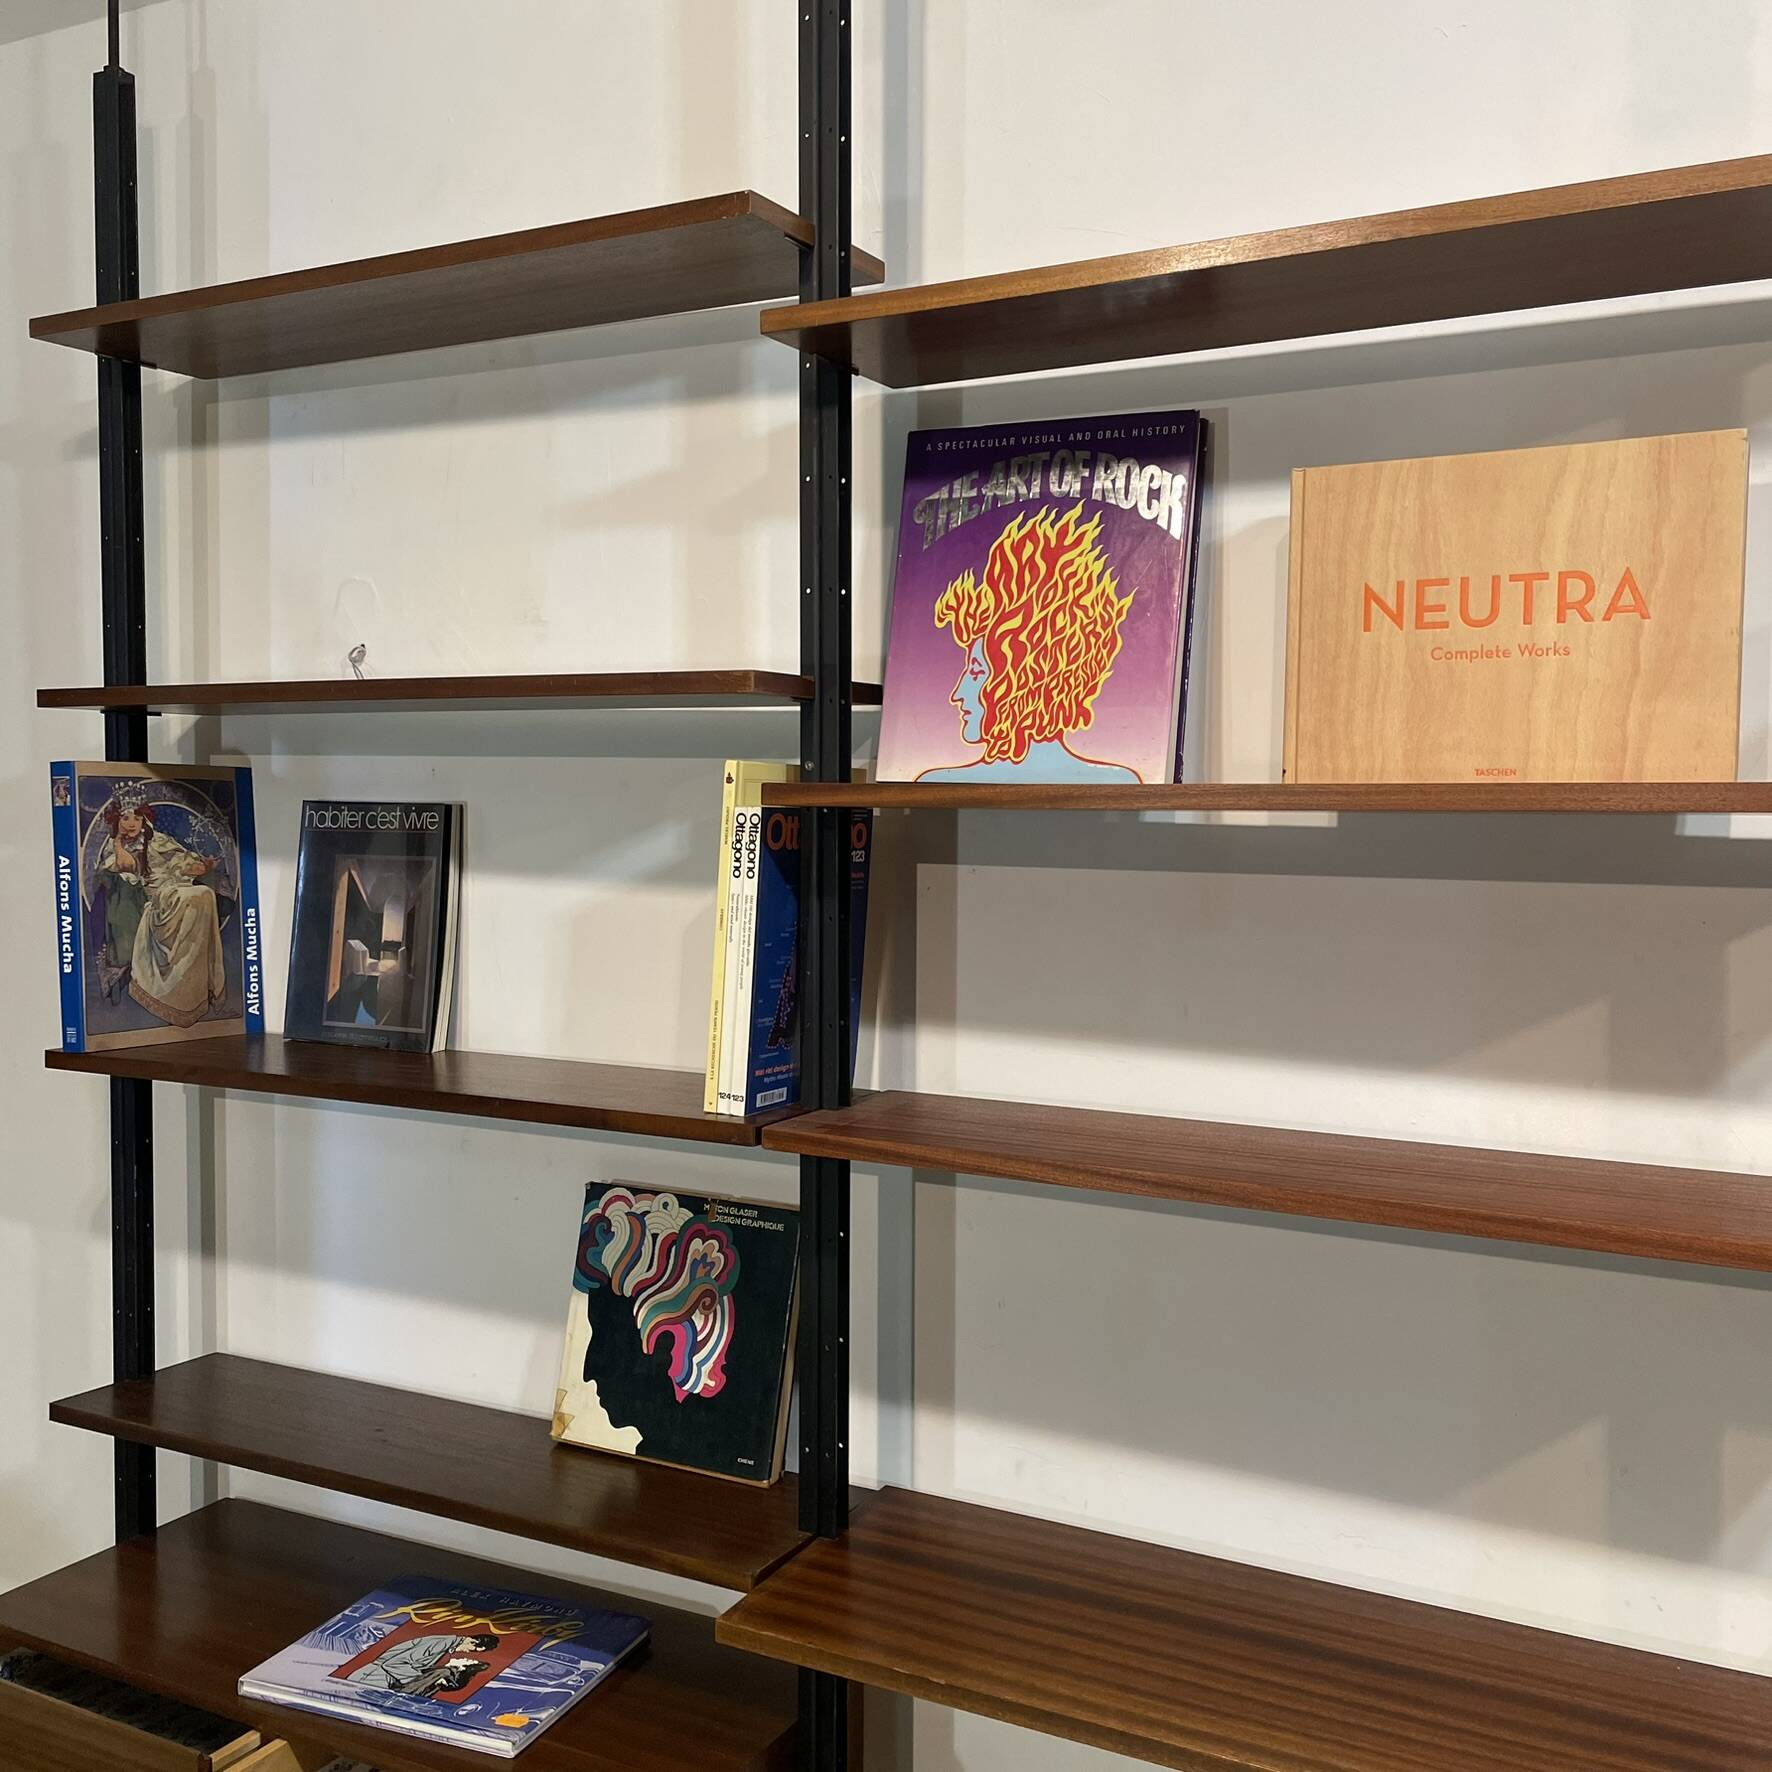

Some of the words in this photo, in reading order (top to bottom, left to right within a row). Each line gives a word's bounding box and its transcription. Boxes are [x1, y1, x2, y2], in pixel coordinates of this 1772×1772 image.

[926, 443, 932, 452] A
[937, 437, 1015, 451] SPECTACULAR
[1021, 433, 1063, 445] VISUAL
[1069, 431, 1091, 442] AND
[1097, 428, 1126, 440] ORAL
[1132, 425, 1186, 437] HISTORY
[913, 470, 981, 552] THE
[981, 451, 1051, 512] ART
[1049, 449, 1093, 499] OF
[1093, 451, 1187, 541] ROCK
[1362, 566, 1651, 632] NEUTRA
[1430, 644, 1512, 663] Complete
[1517, 641, 1570, 658] Works
[1474, 768, 1517, 777] TASCHEN
[305, 805, 365, 829] habiter
[403, 807, 439, 829] vivre
[731, 812, 747, 879] Ottagono
[745, 812, 761, 880] Ottagono
[58, 855, 71, 911] Alfons
[60, 914, 74, 974] Mucha
[244, 907, 257, 960] Mucha
[246, 963, 260, 1015] Alfons
[718, 1092, 731, 1101] 124
[732, 1094, 744, 1102] 123
[704, 1204, 730, 1214] MTON
[729, 1207, 758, 1217] GLASER
[713, 1214, 741, 1225] DESIGN
[741, 1218, 785, 1231] GRAPHIQUE
